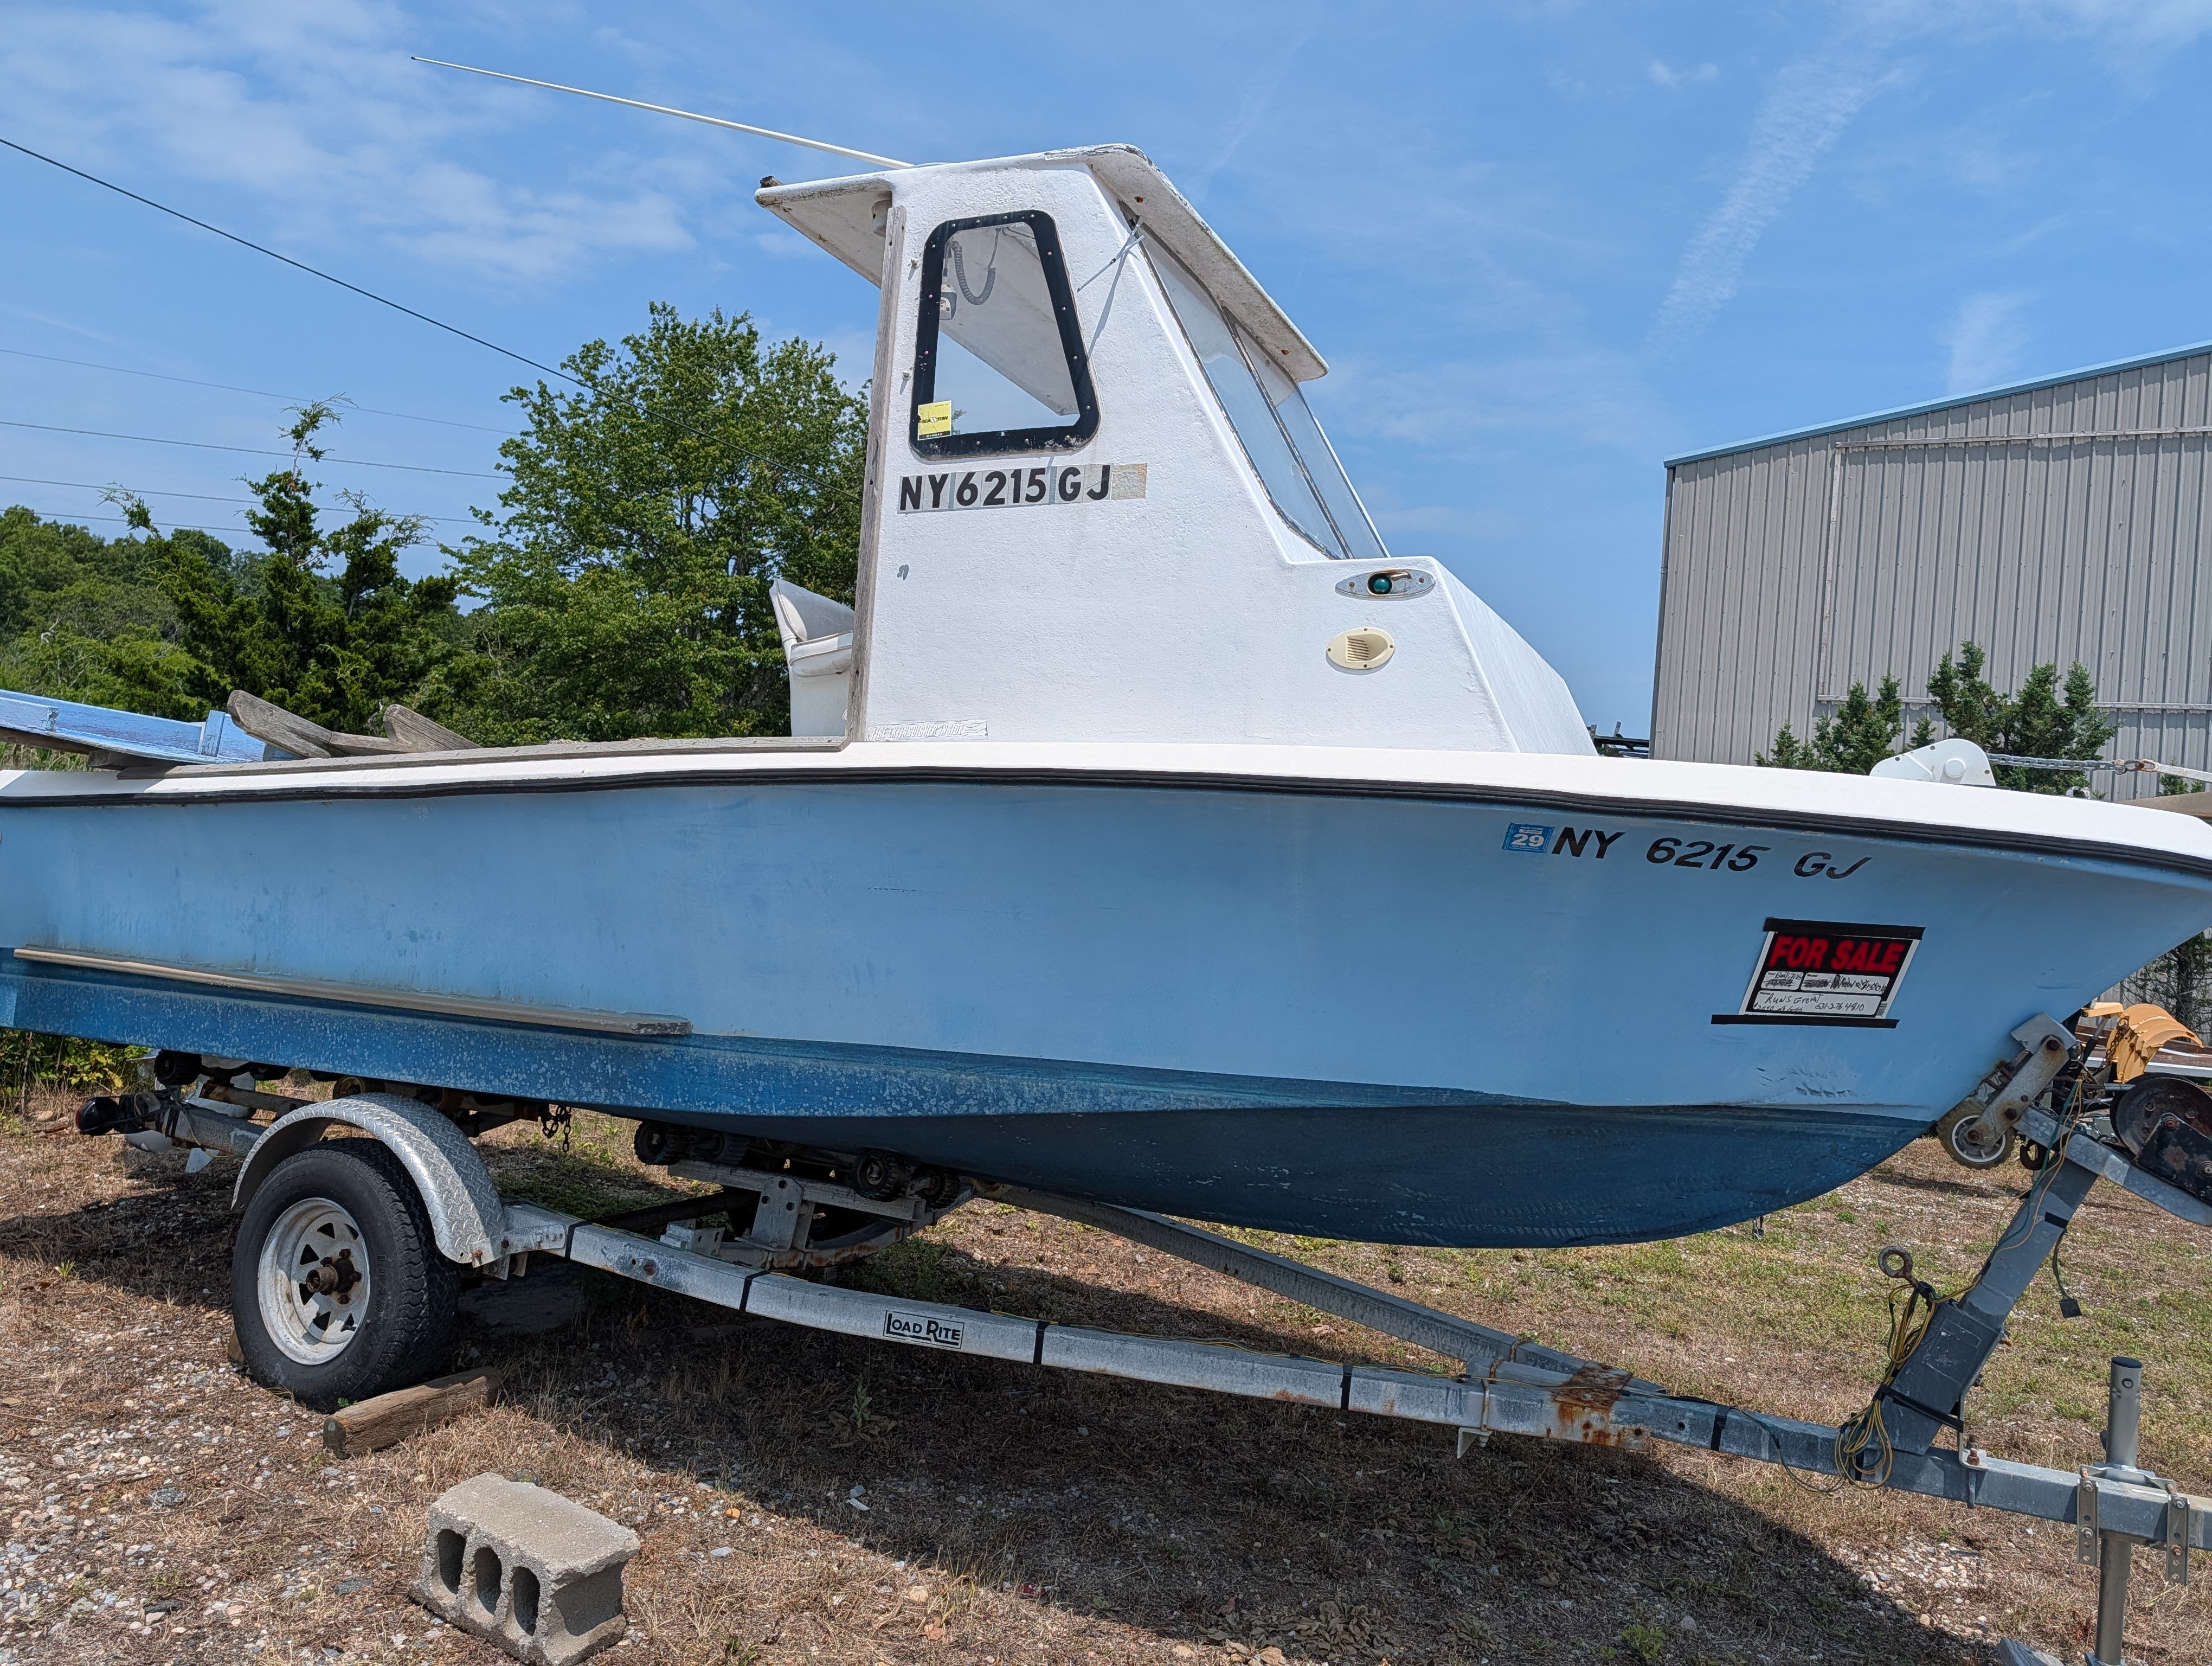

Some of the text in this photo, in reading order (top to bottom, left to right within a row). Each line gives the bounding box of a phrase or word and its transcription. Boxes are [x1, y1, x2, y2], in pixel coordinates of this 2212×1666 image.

[900, 465, 1110, 510] NY 6215 GJ
[1511, 834, 1544, 847] 29
[1551, 826, 1625, 859] NY
[1645, 837, 1771, 872] 6215
[1793, 852, 1872, 879] GJ
[1769, 936, 1905, 972] FOR SALE
[886, 1313, 961, 1343] LOAD RITE
